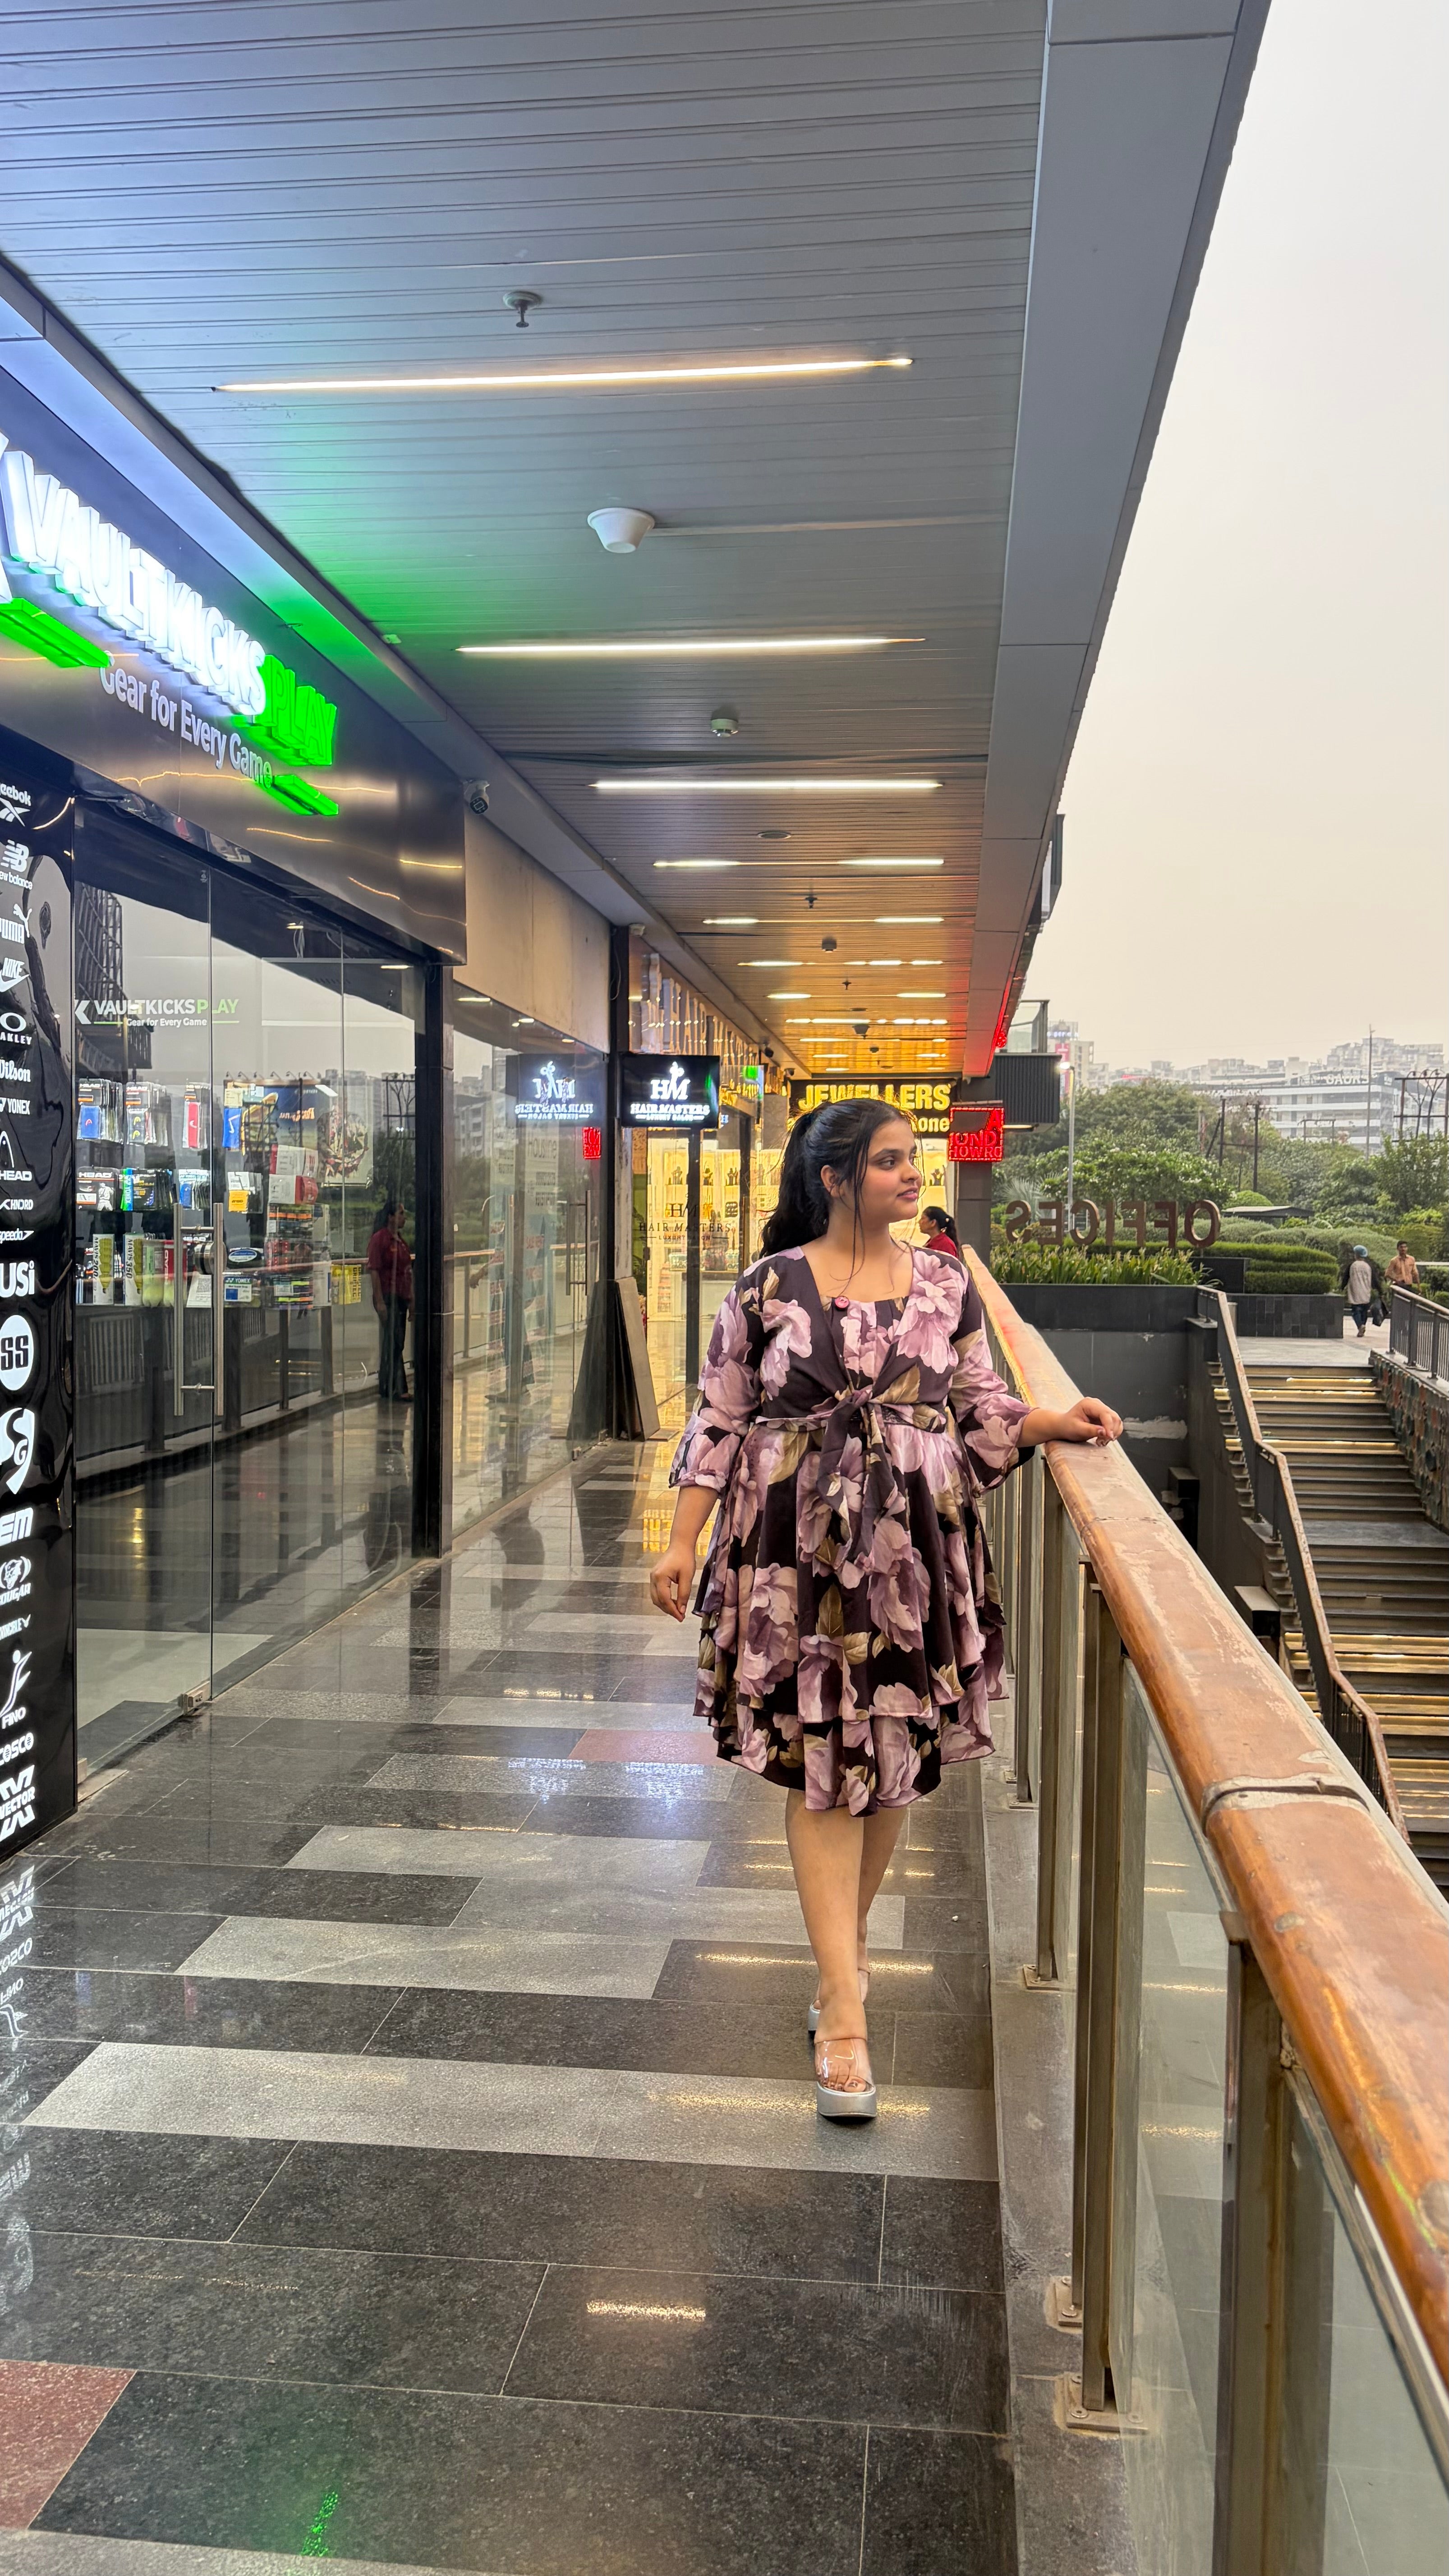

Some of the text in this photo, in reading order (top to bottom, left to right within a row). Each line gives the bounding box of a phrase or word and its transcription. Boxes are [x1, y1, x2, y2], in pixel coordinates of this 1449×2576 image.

[1, 451, 337, 766] VAULTKICKS PLAY
[100, 650, 273, 789] Gear for Every Game
[0, 782, 32, 806] eebok
[0, 870, 33, 890] ew balance
[0, 917, 24, 944] UMA
[2, 957, 25, 978] NIKE
[94, 999, 196, 1015] VAULTKICKS
[146, 1018, 158, 1026] for
[160, 1019, 182, 1028] Every
[0, 1032, 32, 1045] AKLEY
[7, 1098, 31, 1115] YONEX
[630, 1103, 710, 1115] HAIR MASTERS
[0, 1170, 32, 1181] HEAD
[639, 1222, 731, 1232] HAIR MATERS
[0, 1334, 29, 1371] SS
[0, 1583, 31, 1605] OUGAR
